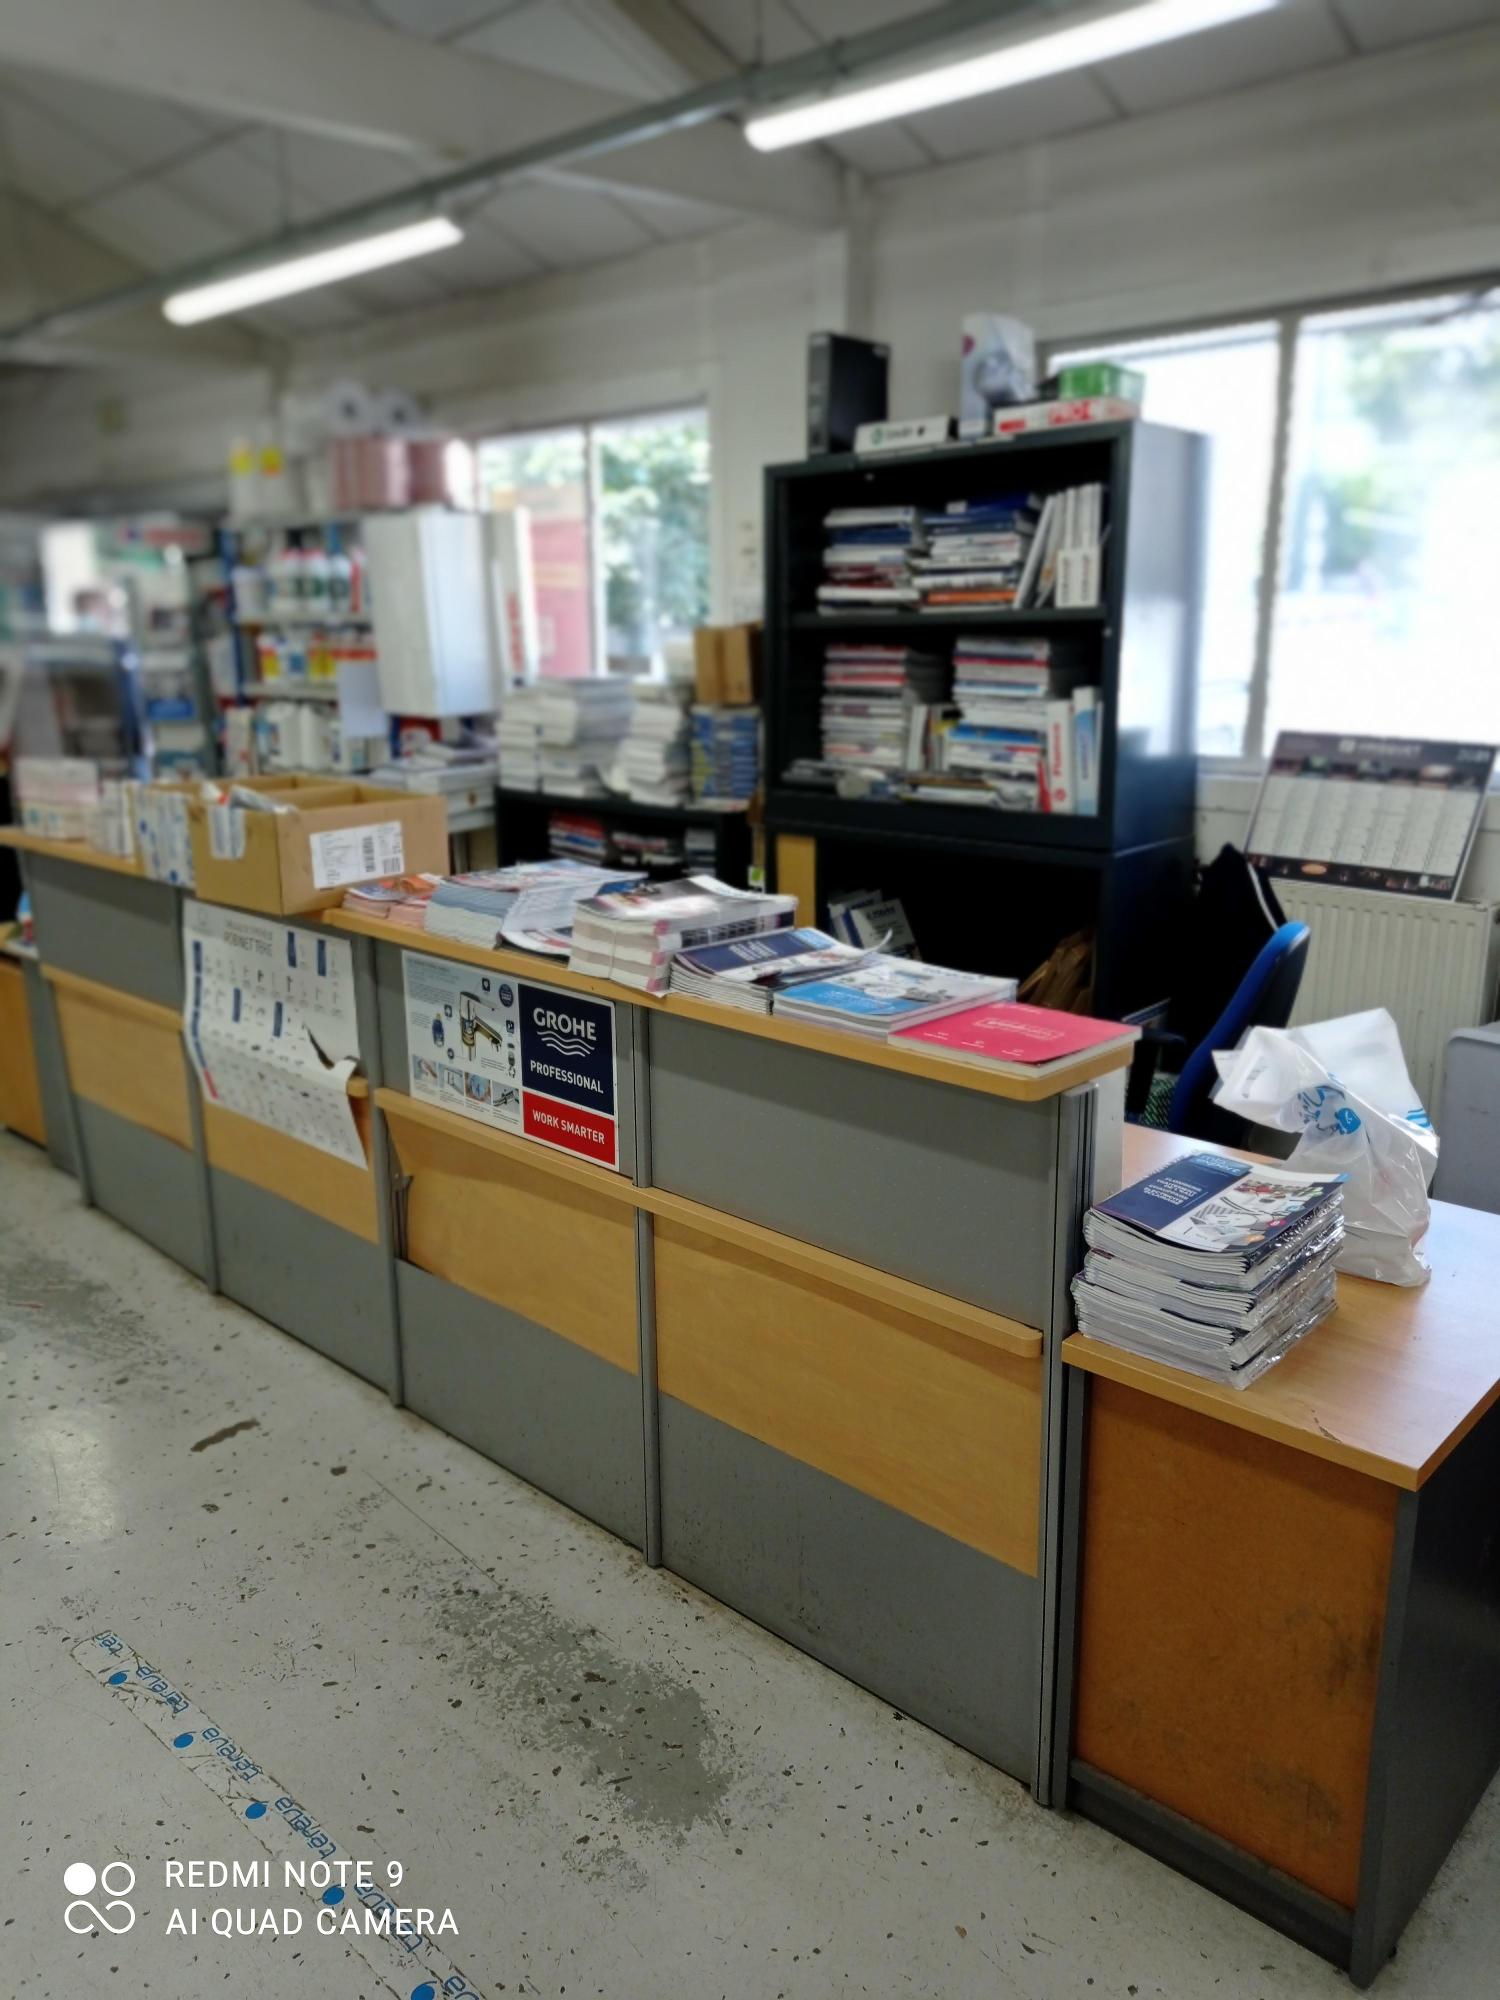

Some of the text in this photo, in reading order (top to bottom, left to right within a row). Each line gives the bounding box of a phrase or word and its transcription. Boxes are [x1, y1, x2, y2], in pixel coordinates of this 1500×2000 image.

[533, 1007, 597, 1041] GROHE
[530, 1060, 604, 1094] PROFESSIONAL
[532, 1109, 560, 1129] WORK
[560, 1119, 605, 1145] SMARTER
